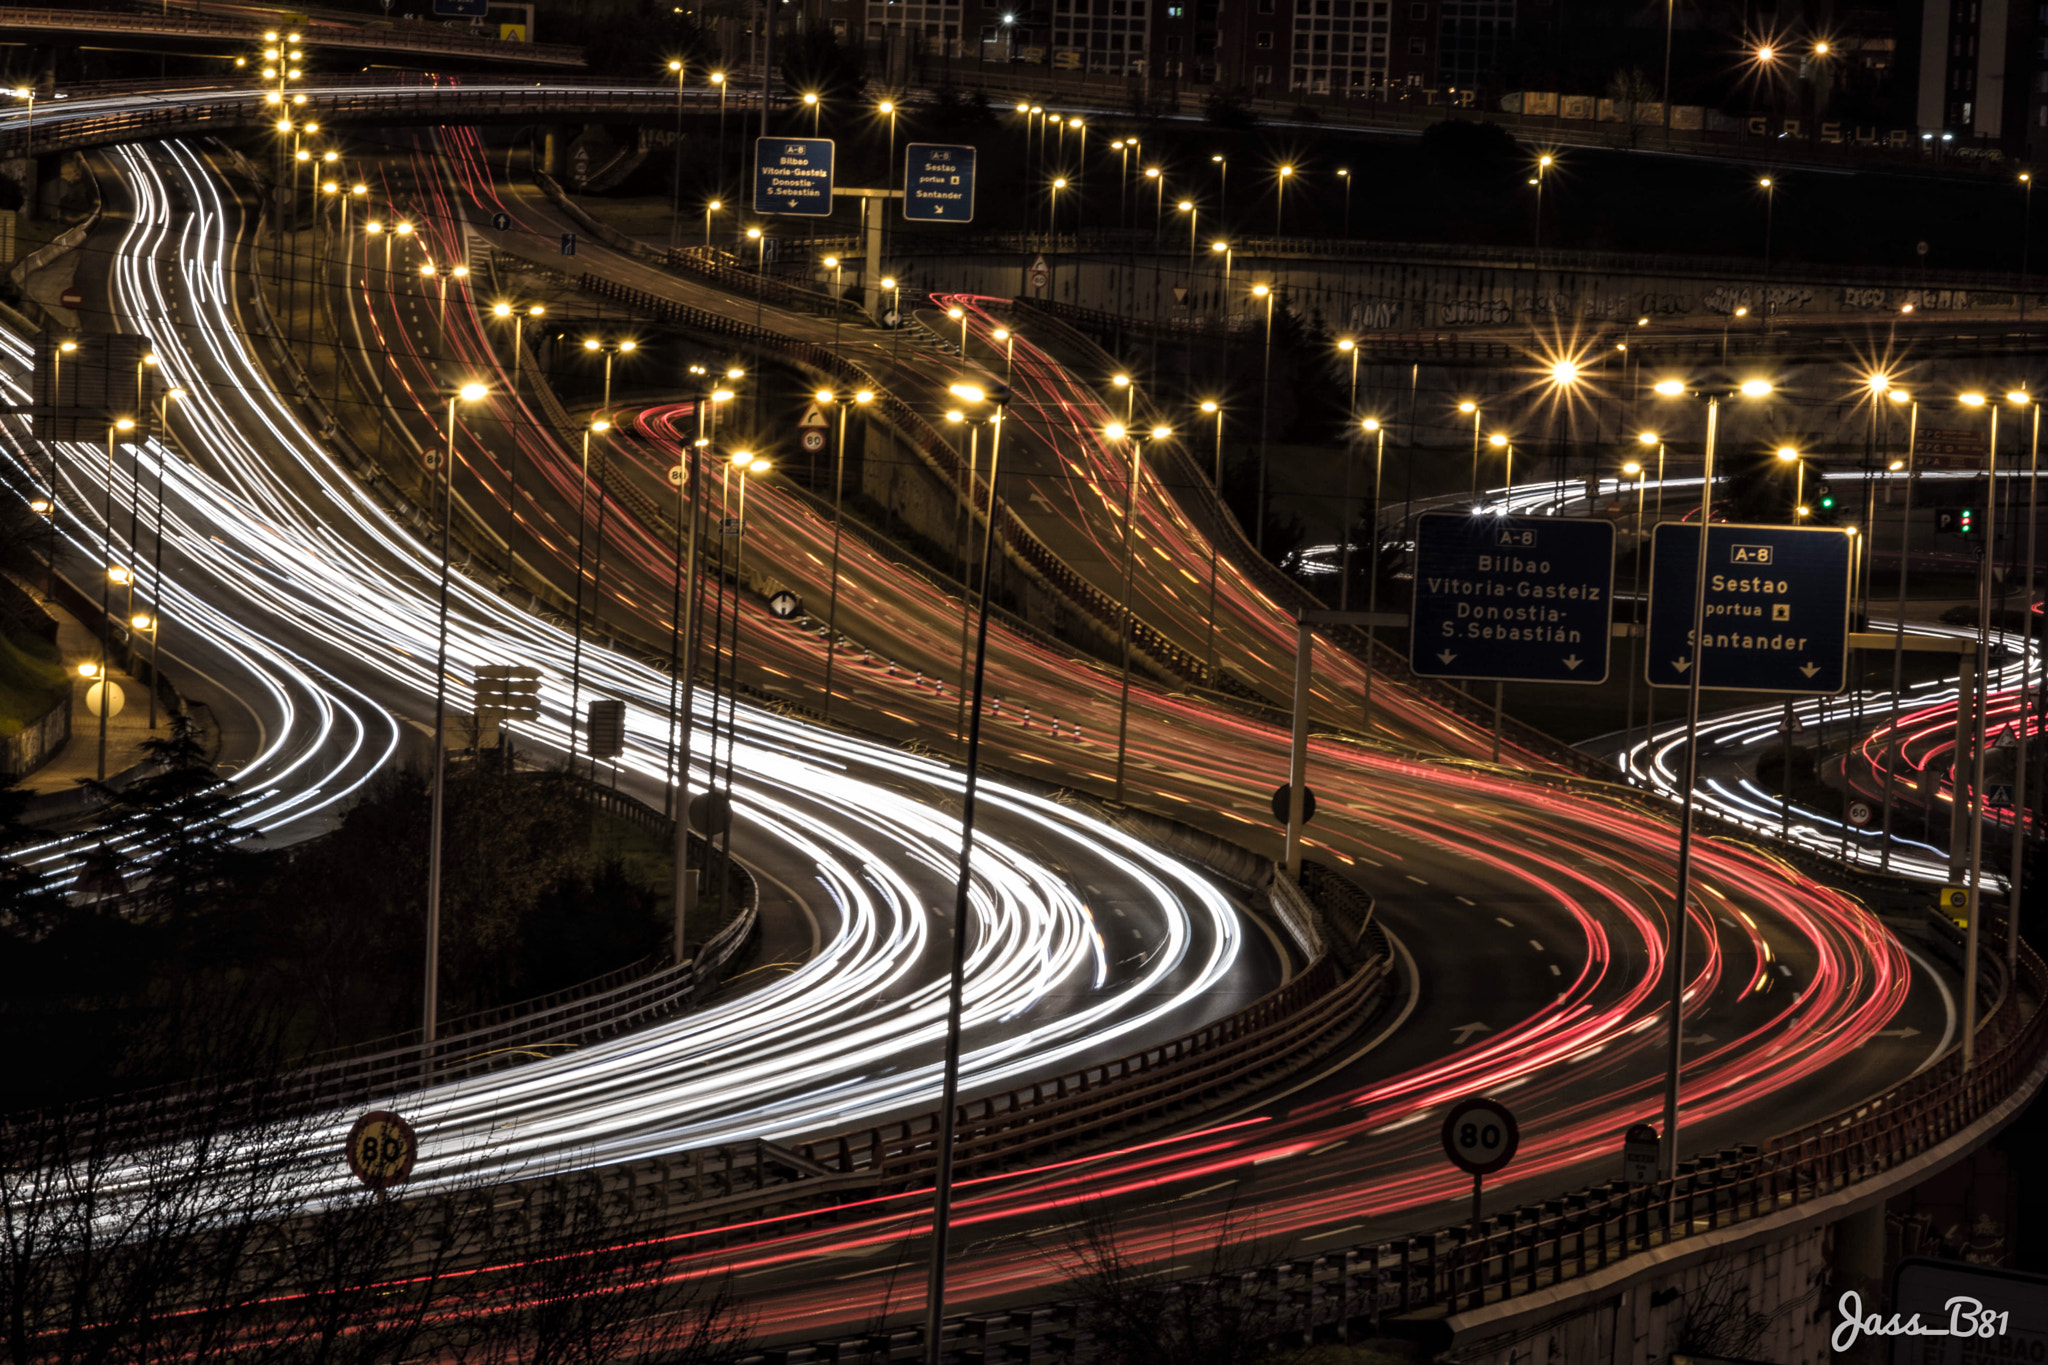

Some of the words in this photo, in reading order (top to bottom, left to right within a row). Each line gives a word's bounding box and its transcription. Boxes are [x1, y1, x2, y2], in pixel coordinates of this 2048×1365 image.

[787, 146, 804, 154] A-8
[779, 157, 809, 166] Bilbao
[924, 162, 957, 172] Sestao
[761, 167, 828, 178] Vitoria-Gasteiz
[919, 175, 945, 184] portua
[772, 178, 815, 187] Donostia-
[915, 189, 963, 199] Santander
[806, 436, 821, 445] 80
[1940, 513, 1951, 528] P
[1499, 531, 1534, 545] A-8
[1734, 547, 1770, 562] A-8
[1478, 555, 1551, 574] Bilbao
[1428, 577, 1601, 601] Vitoria-Gasteiz
[1711, 574, 1789, 594] Sestao
[1456, 602, 1568, 623] Donostia-
[1705, 603, 1763, 618] portua
[1441, 620, 1581, 644] S.Sebastián
[1852, 808, 1867, 818] 60
[1461, 1123, 1500, 1149] 80
[363, 1137, 399, 1162] 80
